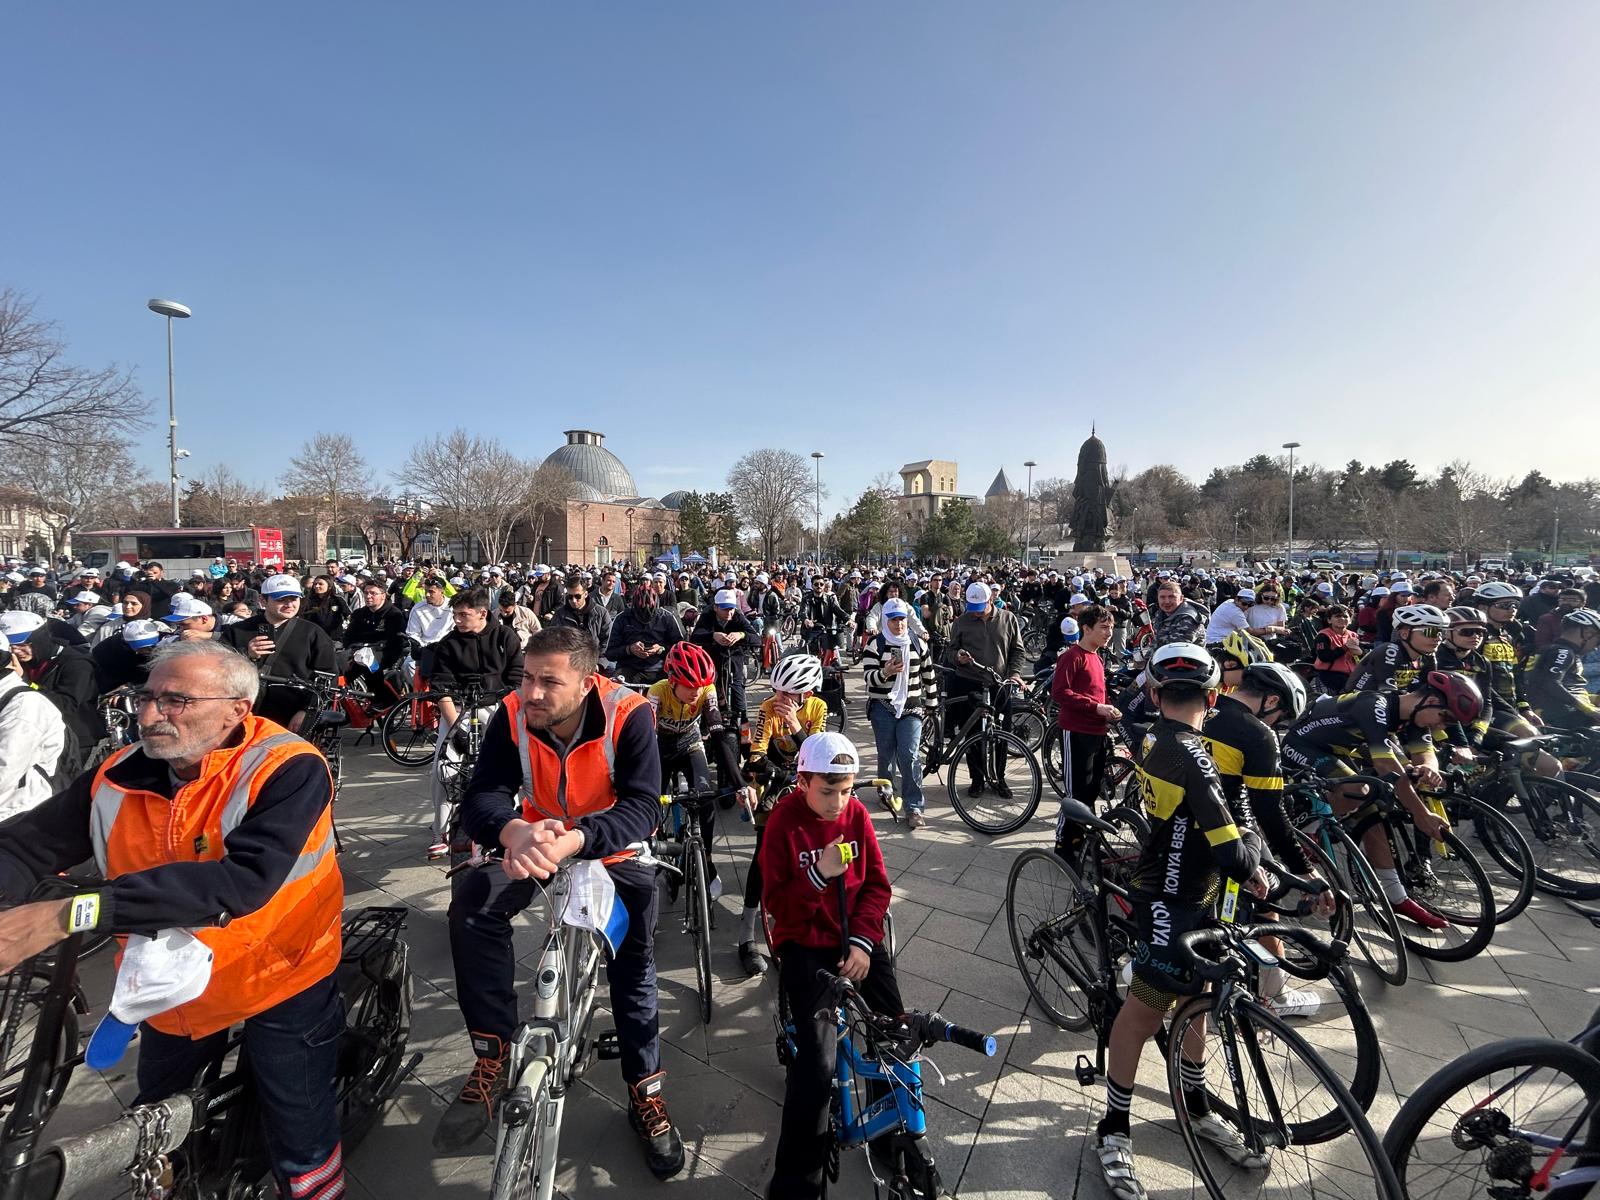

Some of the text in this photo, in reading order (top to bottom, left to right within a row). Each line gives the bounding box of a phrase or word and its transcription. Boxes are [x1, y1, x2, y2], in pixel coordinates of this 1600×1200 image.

[1297, 717, 1343, 736] KONYA BBSK
[1283, 744, 1308, 766] KONYA
[1163, 815, 1188, 895] KONYA BBSK
[1150, 901, 1172, 947] KONYA
